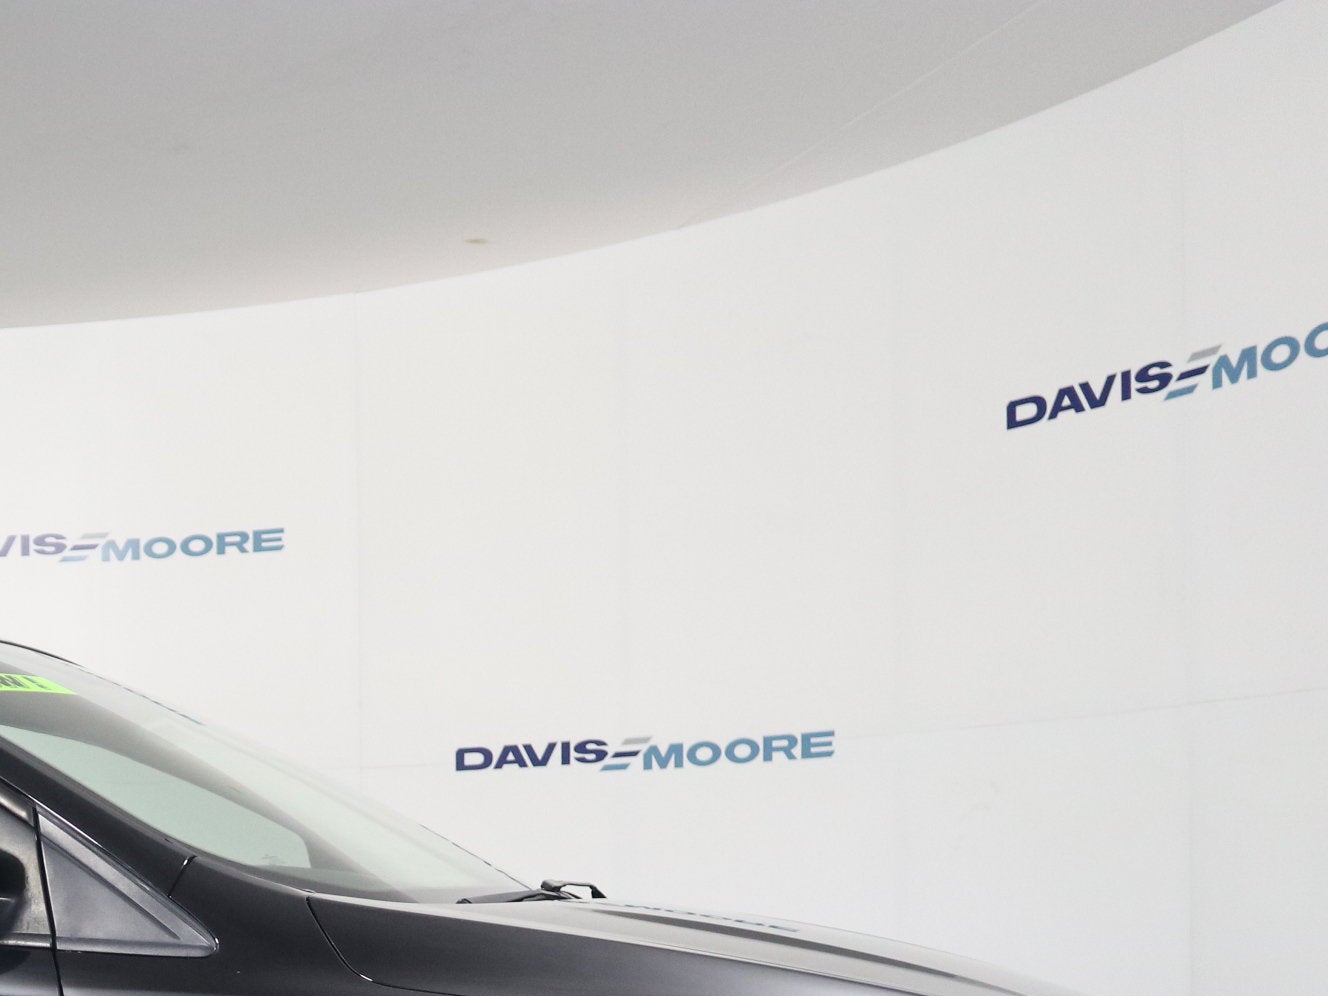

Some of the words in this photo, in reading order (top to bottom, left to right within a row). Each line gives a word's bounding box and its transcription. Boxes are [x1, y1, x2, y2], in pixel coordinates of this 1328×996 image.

[1005, 361, 1174, 430] DAVIS
[101, 527, 285, 562] MOORE
[455, 739, 609, 772] DAVIS
[642, 730, 835, 771] MOORE
